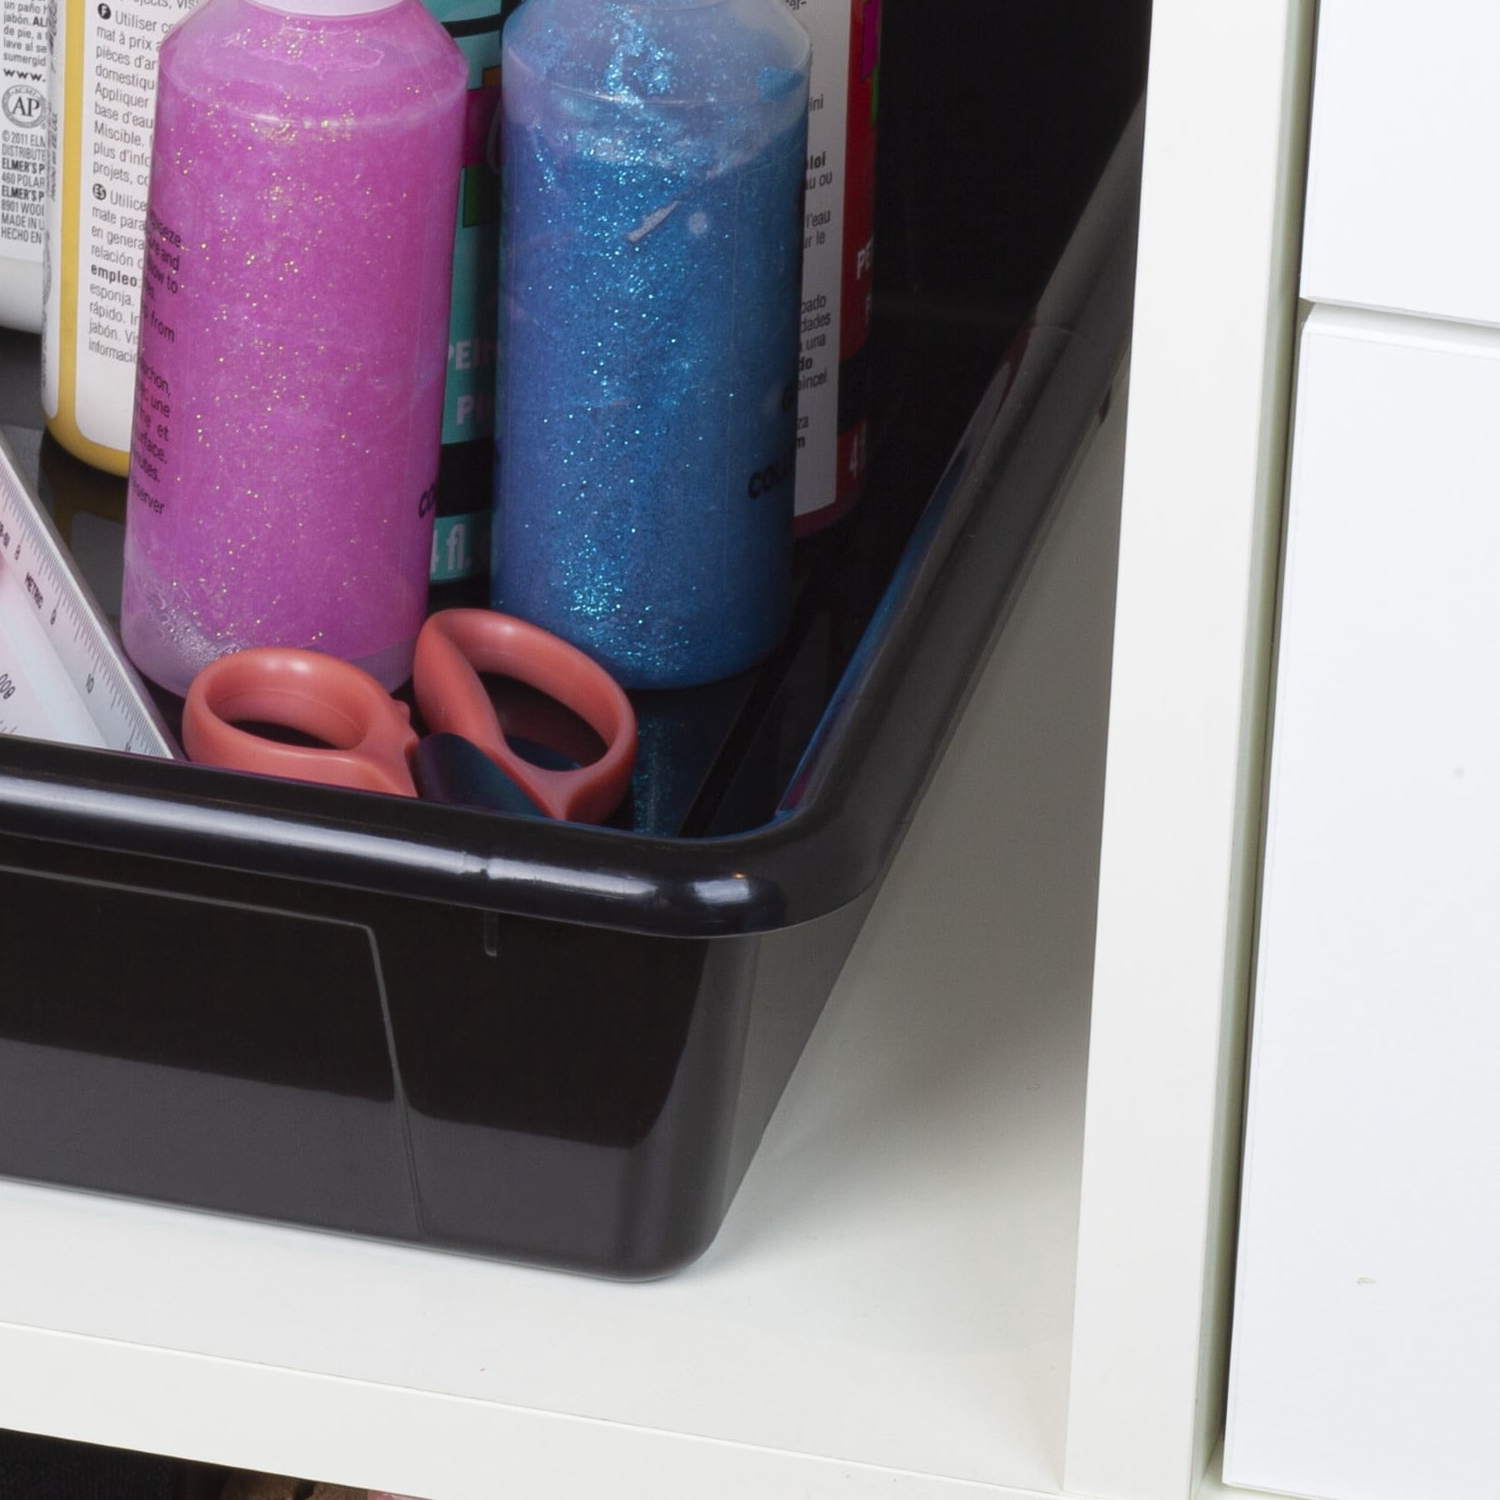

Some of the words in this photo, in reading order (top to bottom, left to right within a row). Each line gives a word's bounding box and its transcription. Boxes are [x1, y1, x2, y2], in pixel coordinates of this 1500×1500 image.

[4, 0, 15, 10] un
[3, 25, 15, 36] de
[115, 10, 158, 32] Utiliser
[3, 37, 22, 50] lave
[25, 40, 33, 52] al
[97, 25, 116, 42] mat
[119, 32, 126, 46] à
[129, 35, 152, 52] prix
[3, 51, 46, 67] sumergid
[96, 45, 131, 66] pièces
[3, 67, 46, 83] www.
[95, 64, 156, 91] domestiqu
[94, 81, 149, 109] Appliquer
[11, 95, 40, 117] AP
[94, 102, 119, 122] base
[122, 112, 154, 129] d'eau
[11, 131, 28, 145] 2011
[94, 120, 145, 148] Miscible.
[93, 141, 116, 160] plus
[1, 157, 37, 175] ELMER'S
[93, 161, 134, 187] projets,
[1, 171, 15, 184] 460
[819, 170, 833, 187] ou
[1, 185, 37, 202] ELMER'S
[110, 190, 148, 213] Utilice
[1, 199, 19, 213] 8901
[1, 212, 26, 228] MADE
[28, 216, 37, 230] IN
[92, 205, 117, 224] mate
[120, 215, 146, 230] para
[806, 209, 831, 228] l'eau
[1, 226, 28, 242] HECHO
[31, 230, 42, 244] EN
[91, 225, 103, 239] en
[815, 230, 826, 246] le
[91, 243, 134, 265] relación
[90, 282, 135, 307] esponja.
[166, 275, 179, 295] to
[89, 301, 126, 324] rápido.
[88, 320, 121, 341] jabón.
[151, 310, 176, 344] from
[805, 332, 826, 350] una
[151, 397, 171, 418] une
[156, 423, 170, 442] et
[24, 571, 44, 610] METRIC
